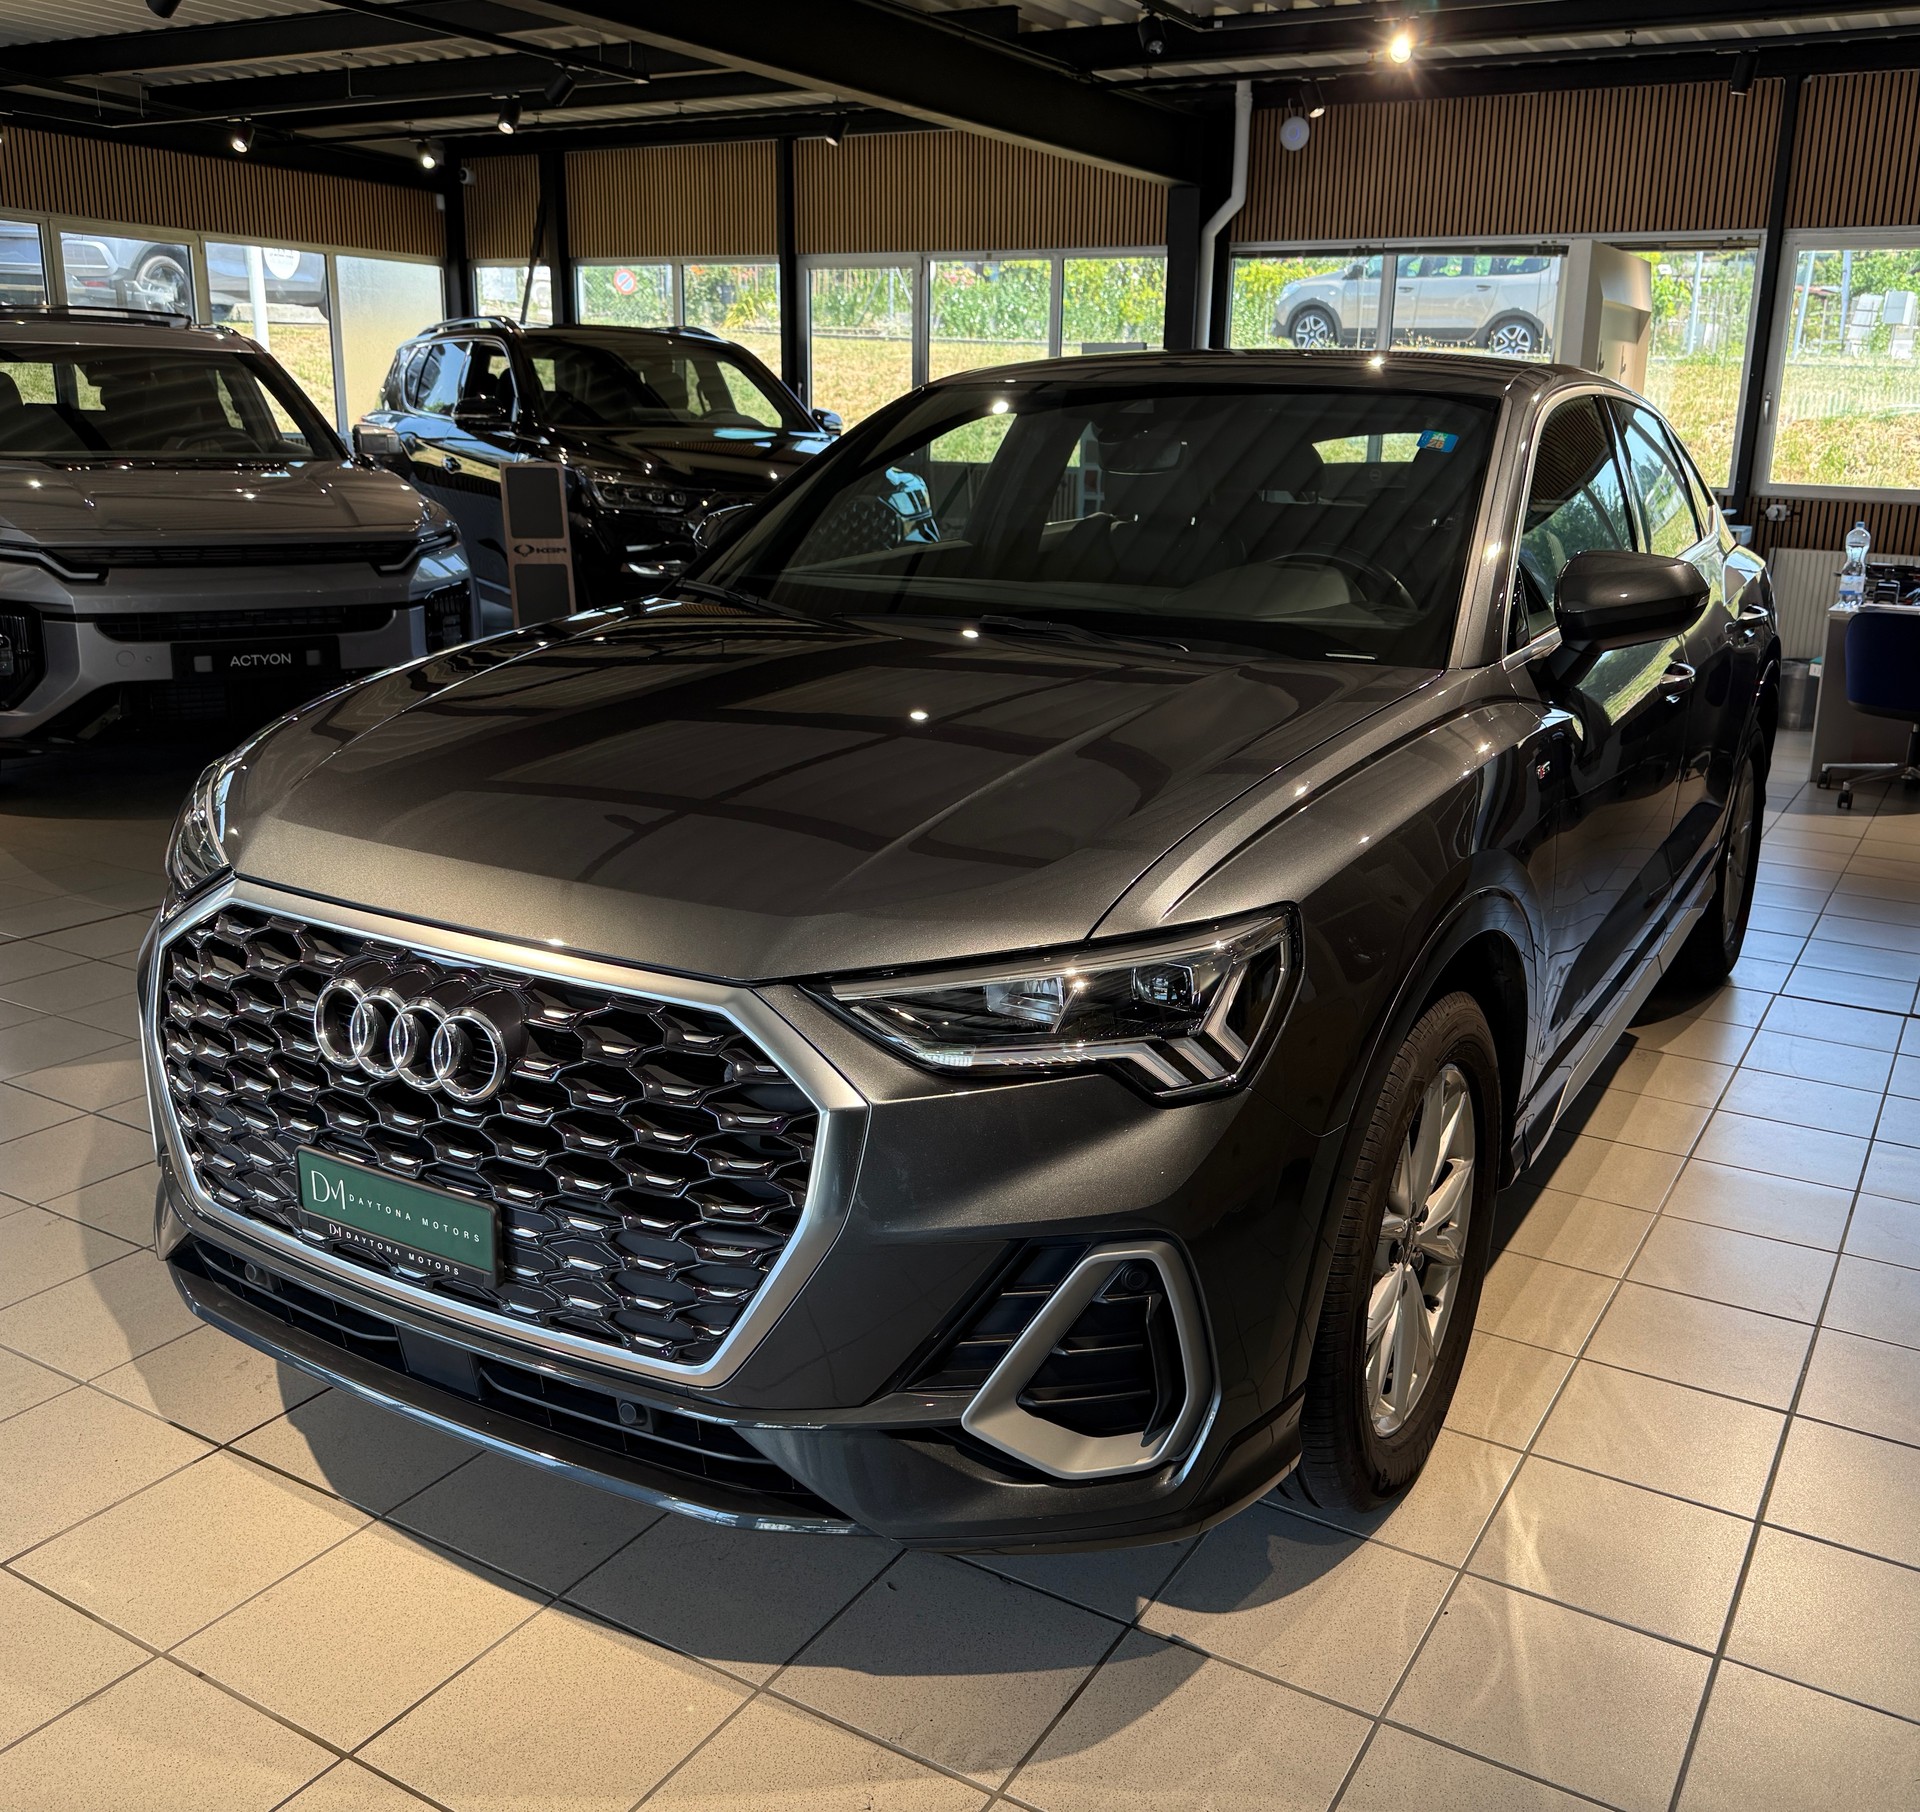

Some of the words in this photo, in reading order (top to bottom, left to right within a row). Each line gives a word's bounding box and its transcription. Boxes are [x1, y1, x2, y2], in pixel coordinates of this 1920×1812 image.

[230, 653, 292, 667] ACTYON
[311, 1170, 346, 1210] DM
[349, 1194, 411, 1220] DAYTONA
[422, 1217, 480, 1242] MOTORS
[346, 1232, 399, 1256] DAYTONA
[408, 1253, 459, 1275] MOTORS
